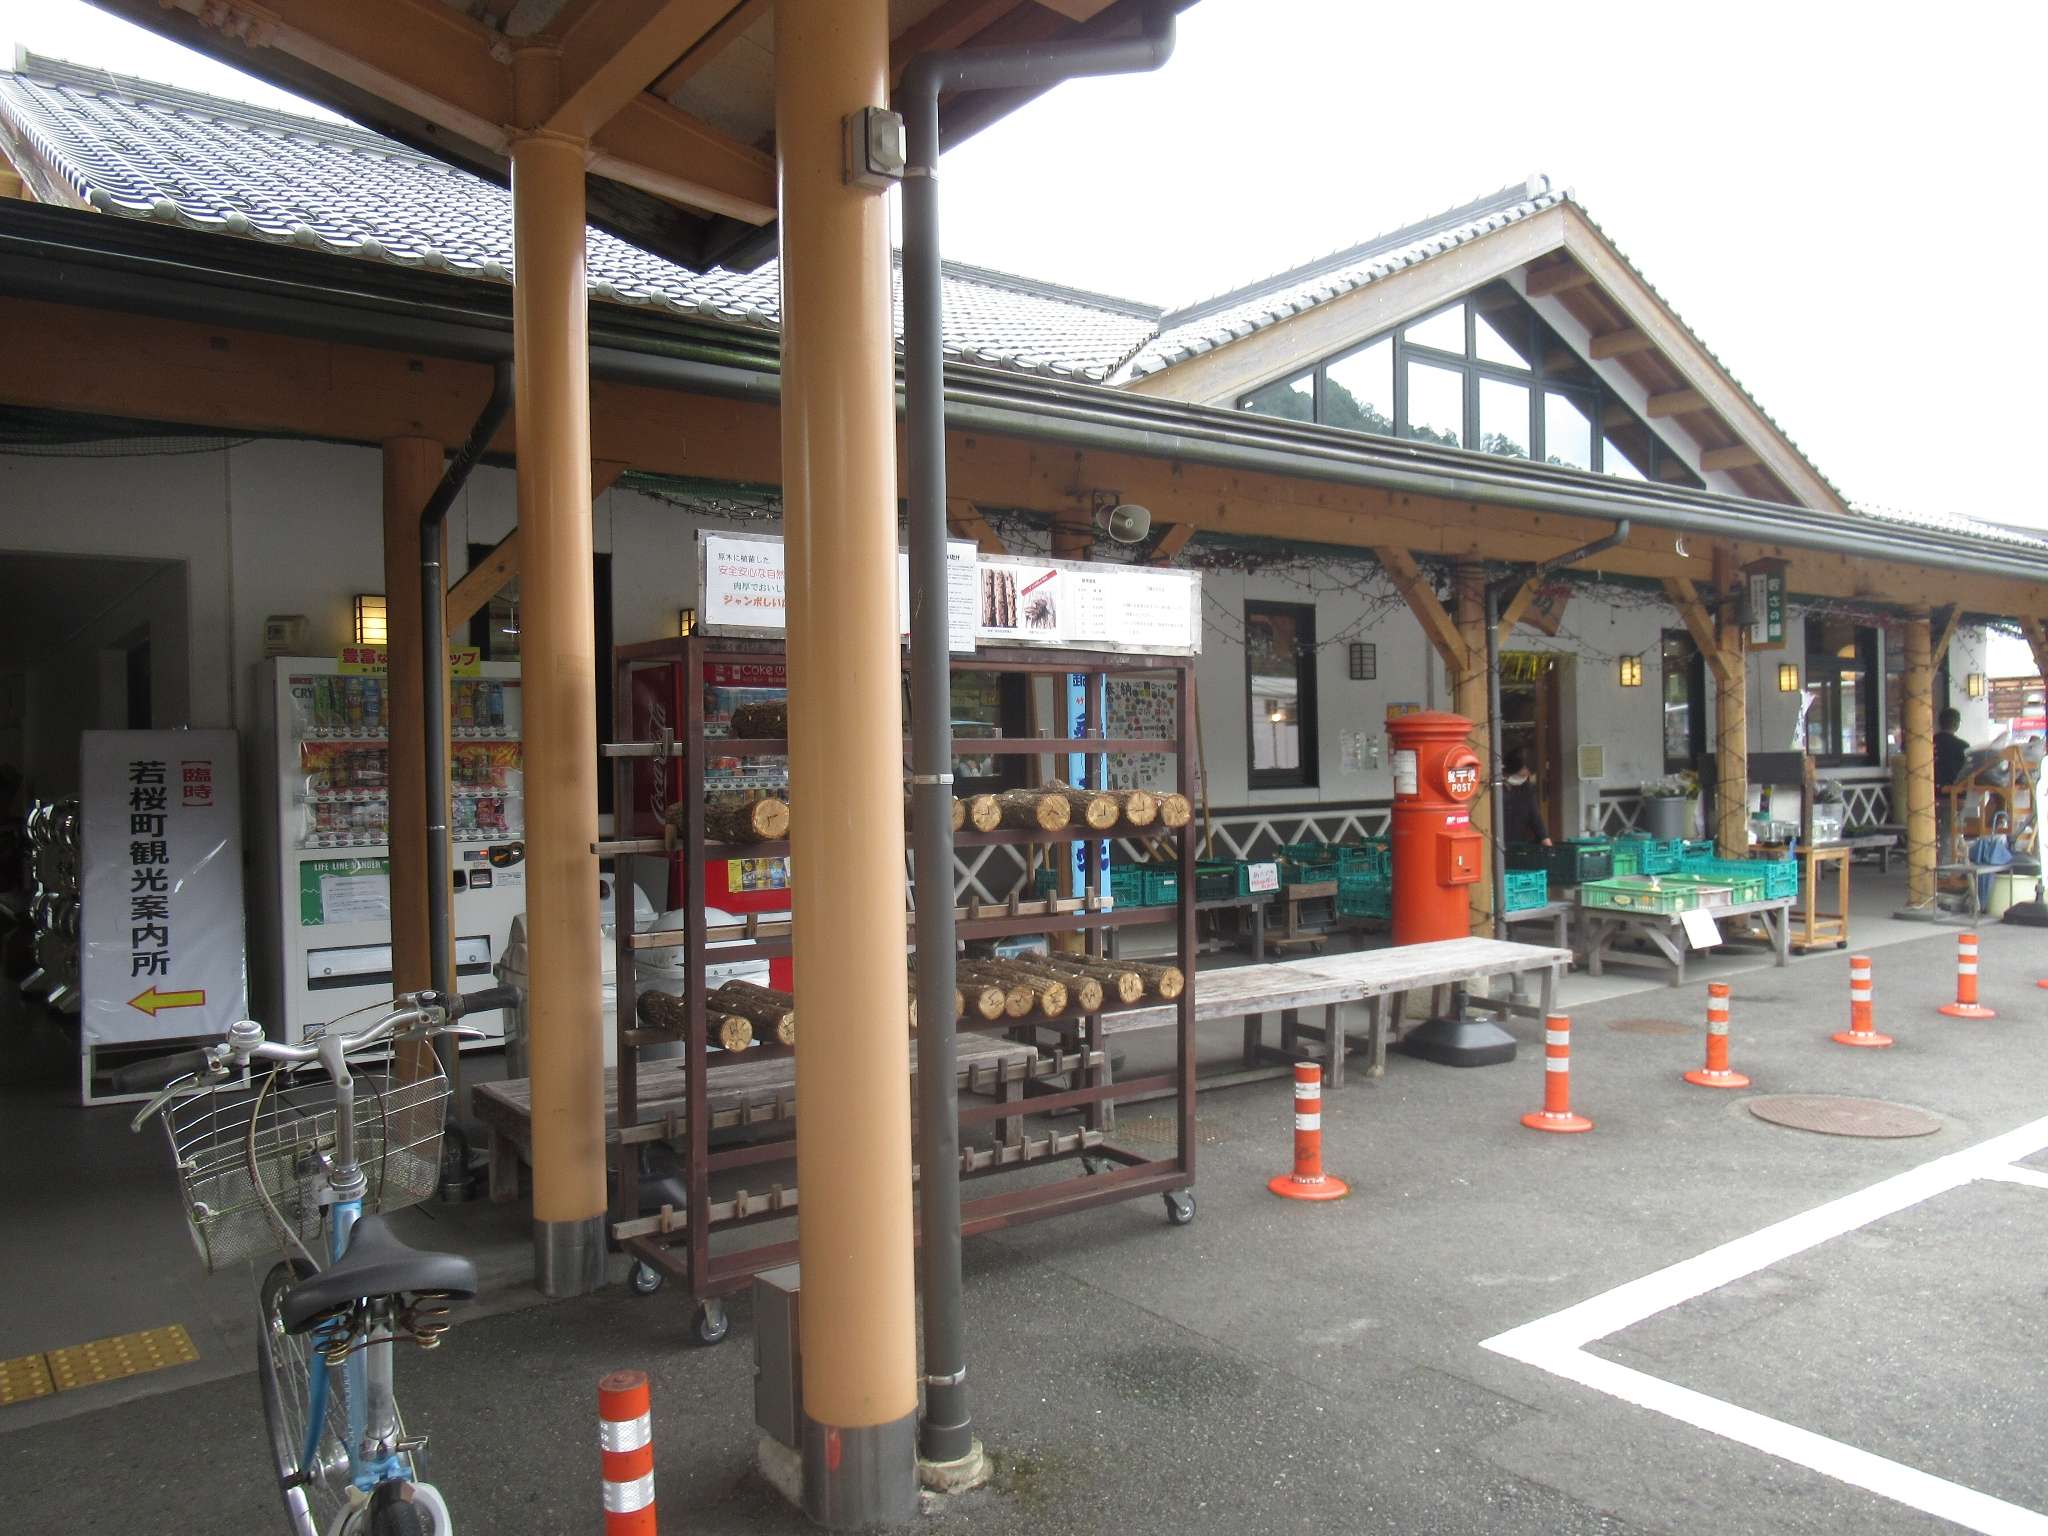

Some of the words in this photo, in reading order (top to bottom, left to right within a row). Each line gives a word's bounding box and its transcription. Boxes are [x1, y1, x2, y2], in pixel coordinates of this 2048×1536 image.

[742, 664, 772, 676] Coke
[1452, 784, 1471, 792] POST
[129, 760, 170, 977] 若桜町観光案内所
